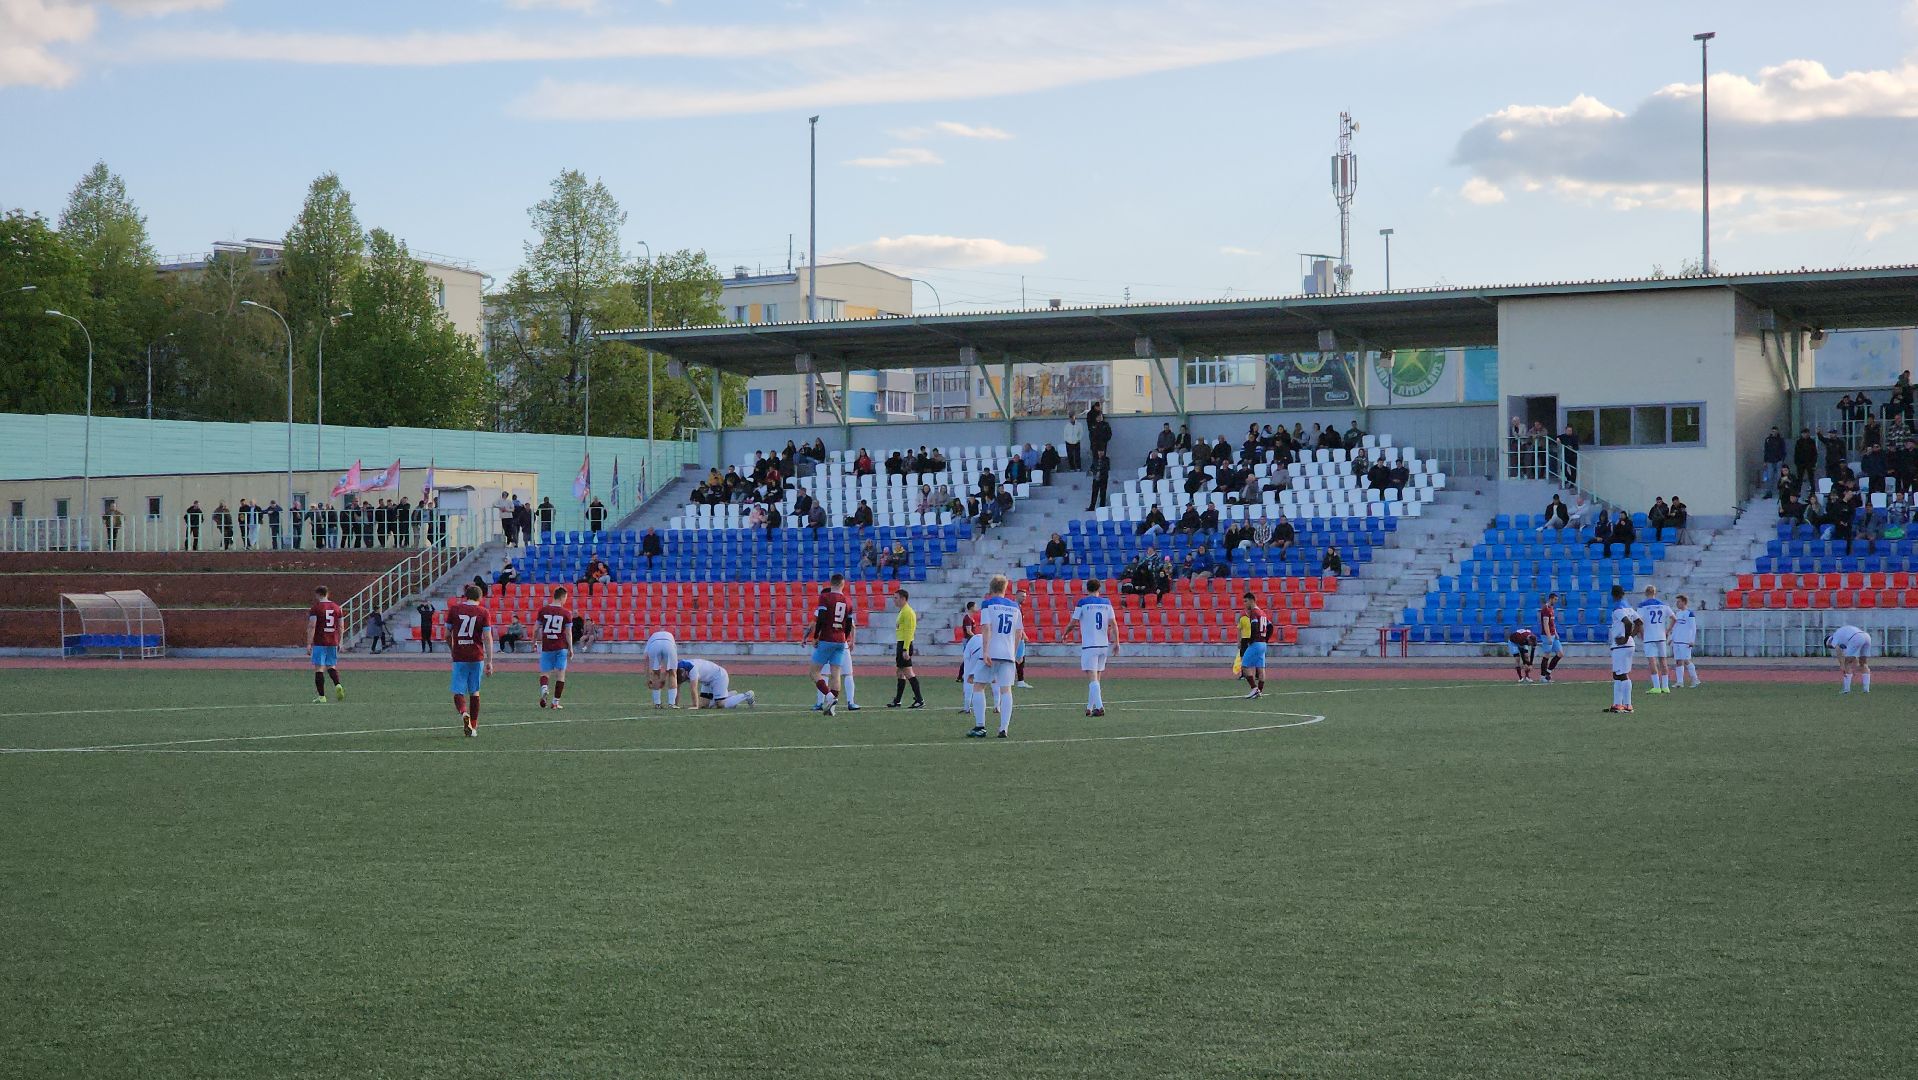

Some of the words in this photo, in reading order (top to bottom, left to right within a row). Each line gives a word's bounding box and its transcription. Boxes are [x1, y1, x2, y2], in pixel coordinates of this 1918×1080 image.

[325, 609, 335, 627] 5
[834, 601, 847, 623] 9
[1095, 611, 1103, 630] 9
[1649, 610, 1663, 624] 22
[457, 614, 477, 638] 21
[543, 614, 564, 633] 29
[997, 613, 1013, 635] 15
